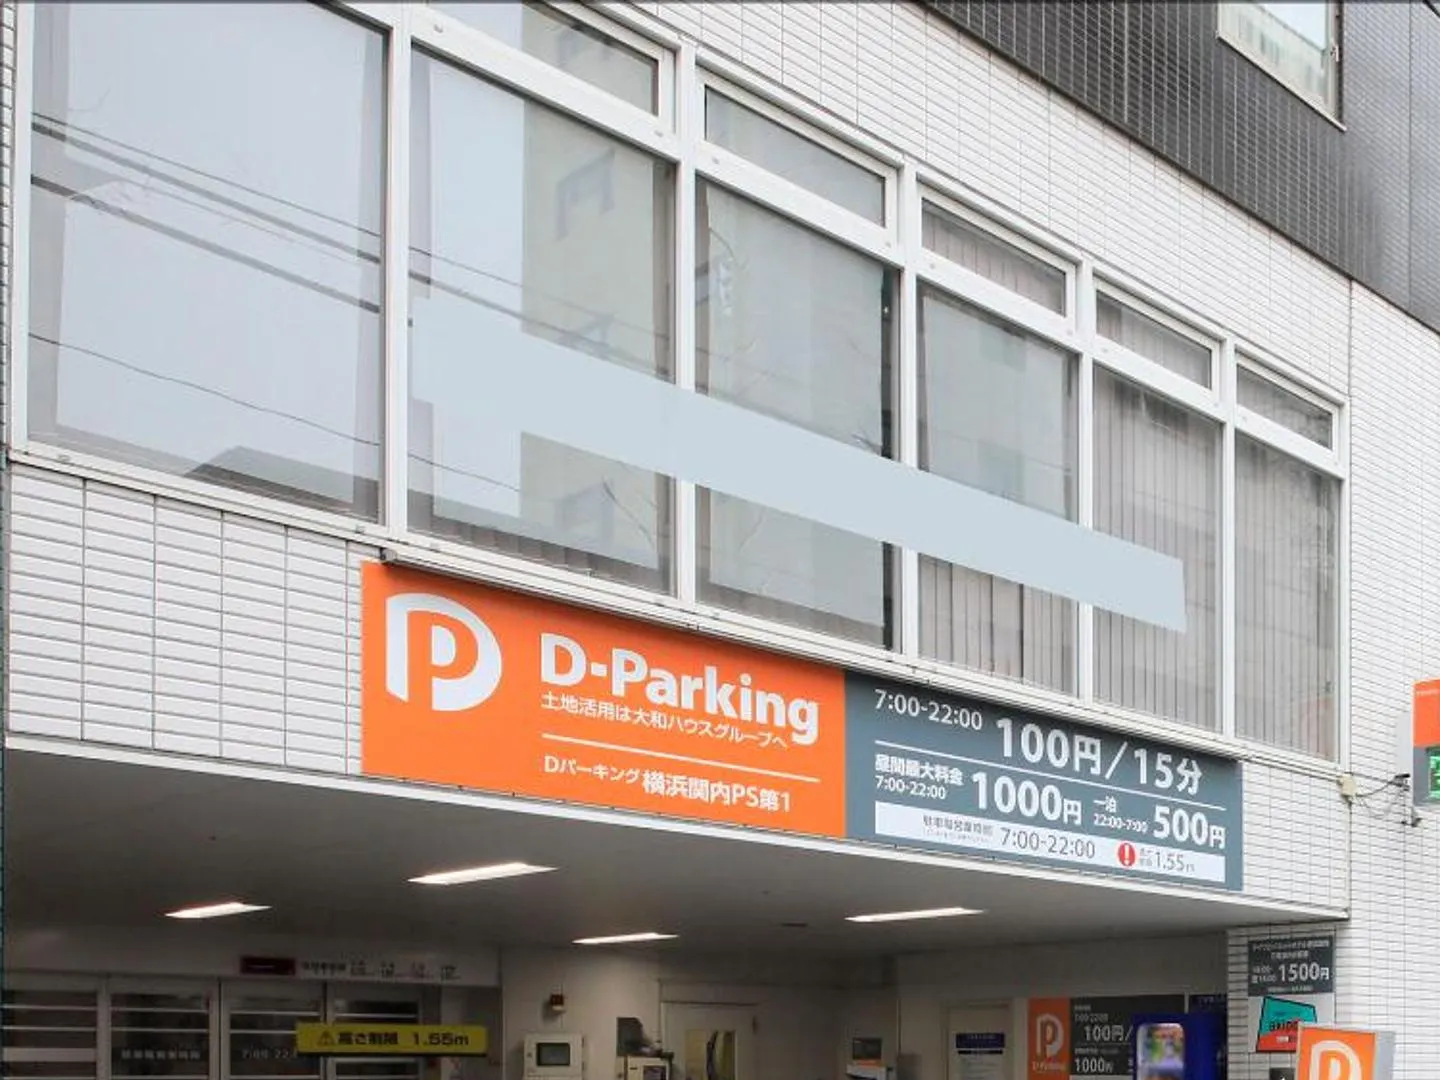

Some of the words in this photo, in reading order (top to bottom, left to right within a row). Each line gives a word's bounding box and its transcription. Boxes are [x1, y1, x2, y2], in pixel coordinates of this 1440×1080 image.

[540, 632, 819, 745] D-Parking
[541, 691, 788, 749] 土地活用は大和ハウスグループへ
[874, 688, 983, 731] 7:00-22:00
[875, 774, 948, 800] 7:00-22:00
[971, 770, 1083, 827] 1000円
[1093, 794, 1117, 814] 一泊
[1093, 812, 1148, 833] 22:00-7:00
[1152, 805, 1226, 850] 500円
[1000, 826, 1096, 860] 7:00-22:00
[1278, 961, 1330, 983] 1500円
[411, 1032, 470, 1047] 1.55m
